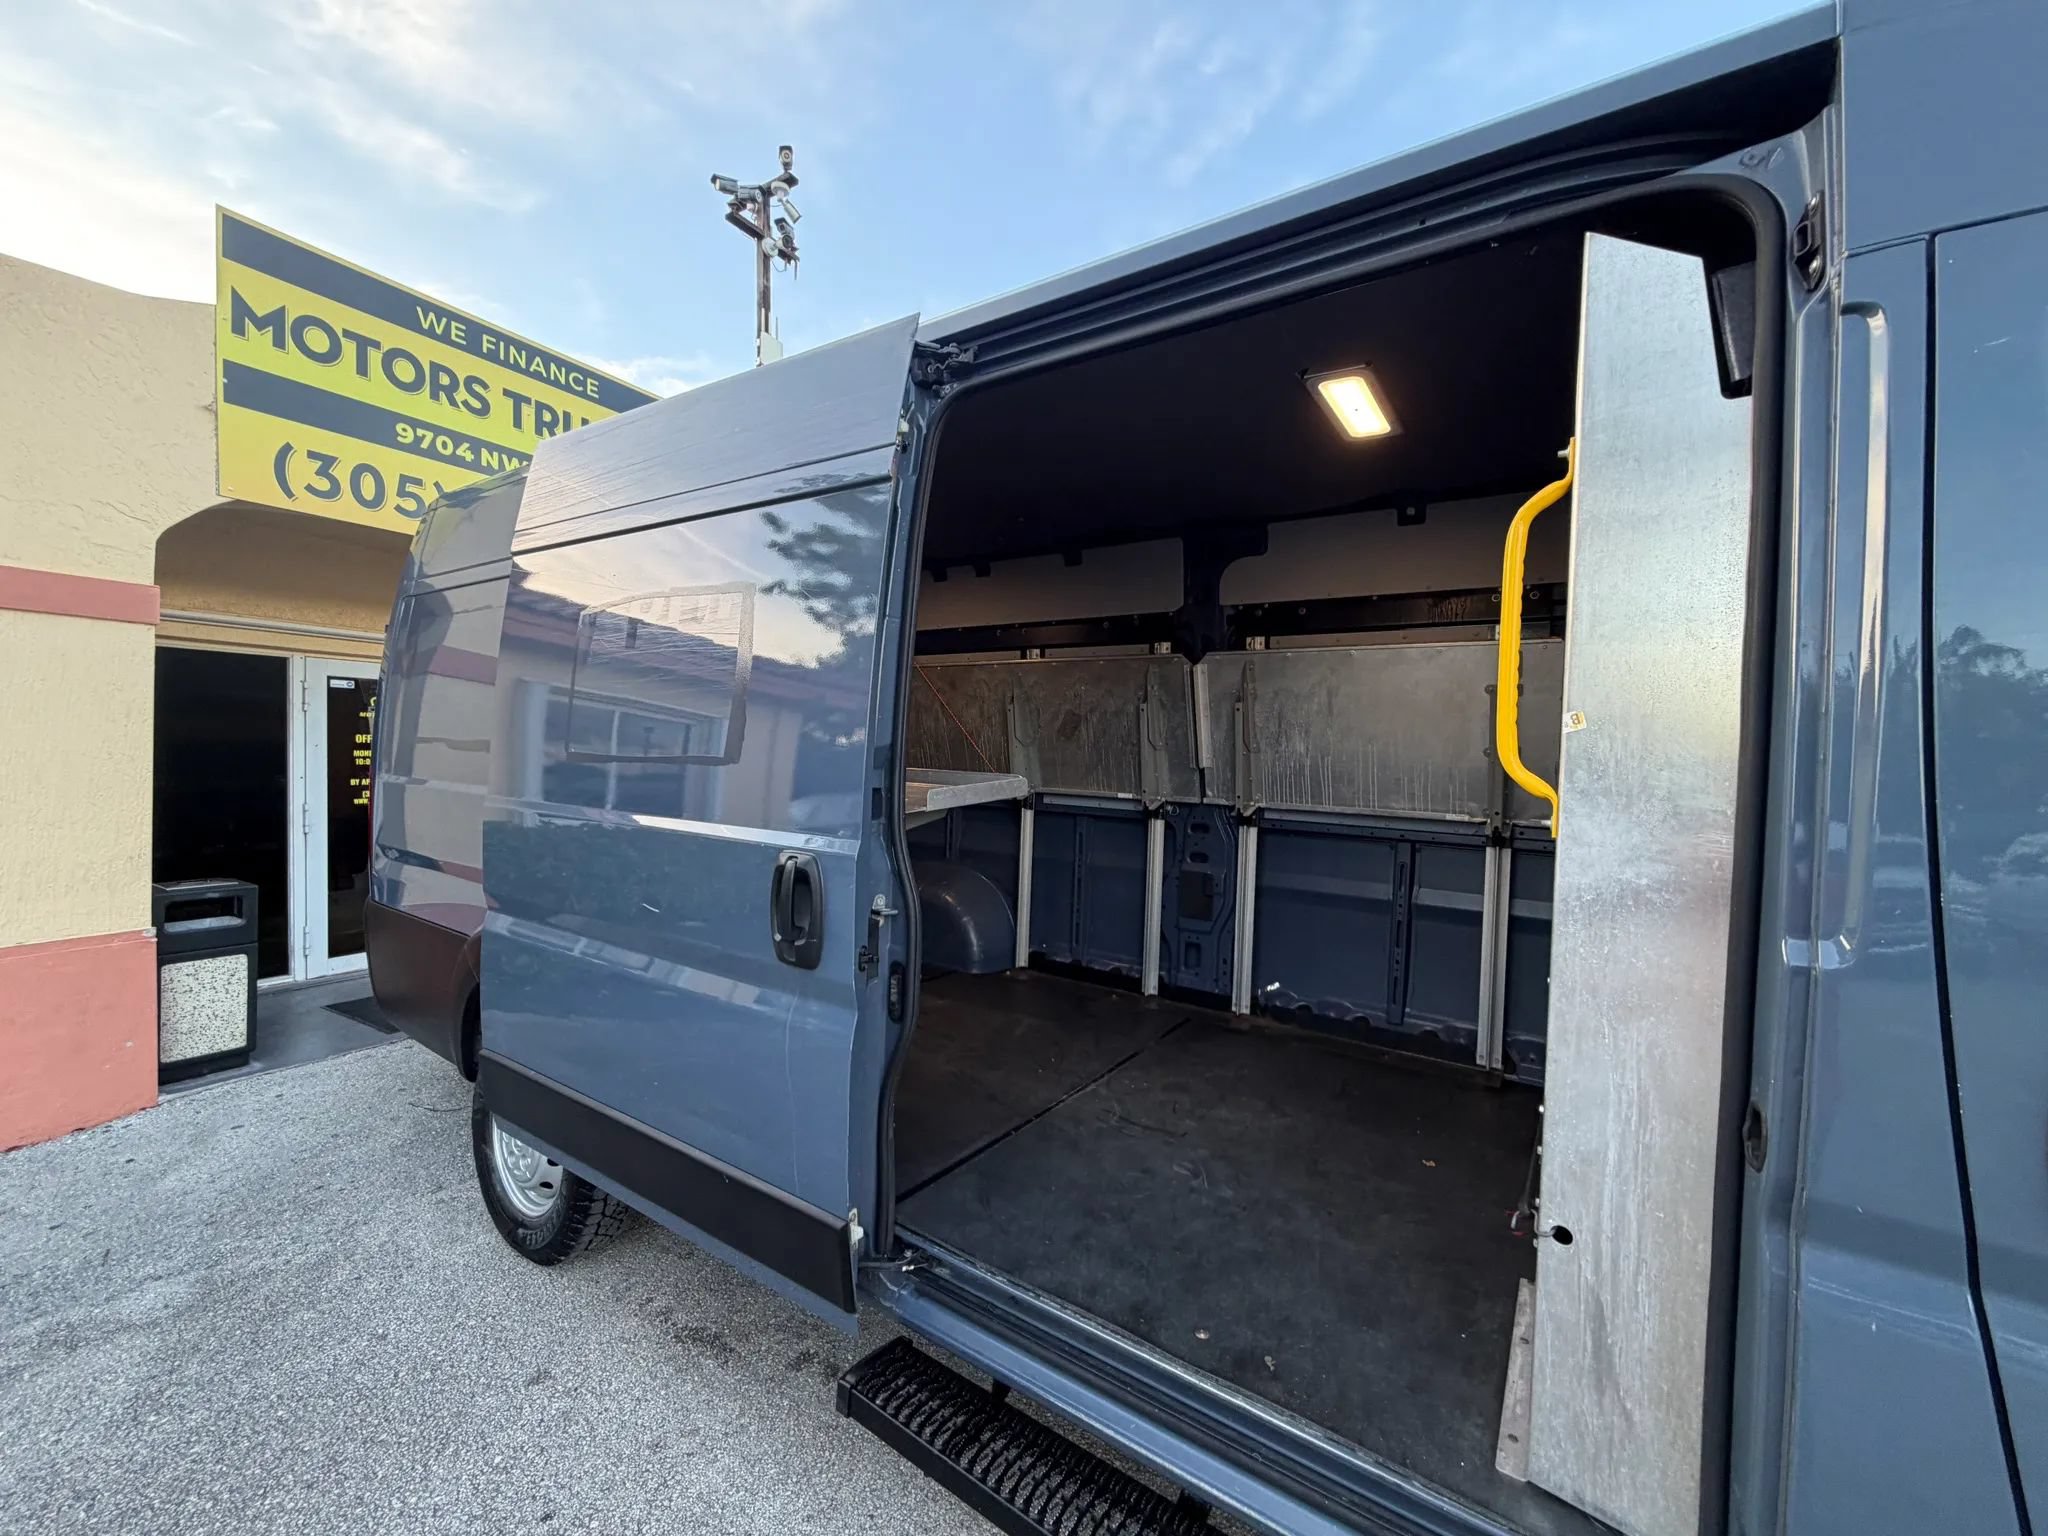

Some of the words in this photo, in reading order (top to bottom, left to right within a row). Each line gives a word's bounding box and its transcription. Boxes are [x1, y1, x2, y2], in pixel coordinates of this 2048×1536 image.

[231, 285, 492, 419] MOTORS
[416, 306, 467, 346] WE
[482, 334, 600, 399] FINANCE
[395, 422, 474, 463] 9704
